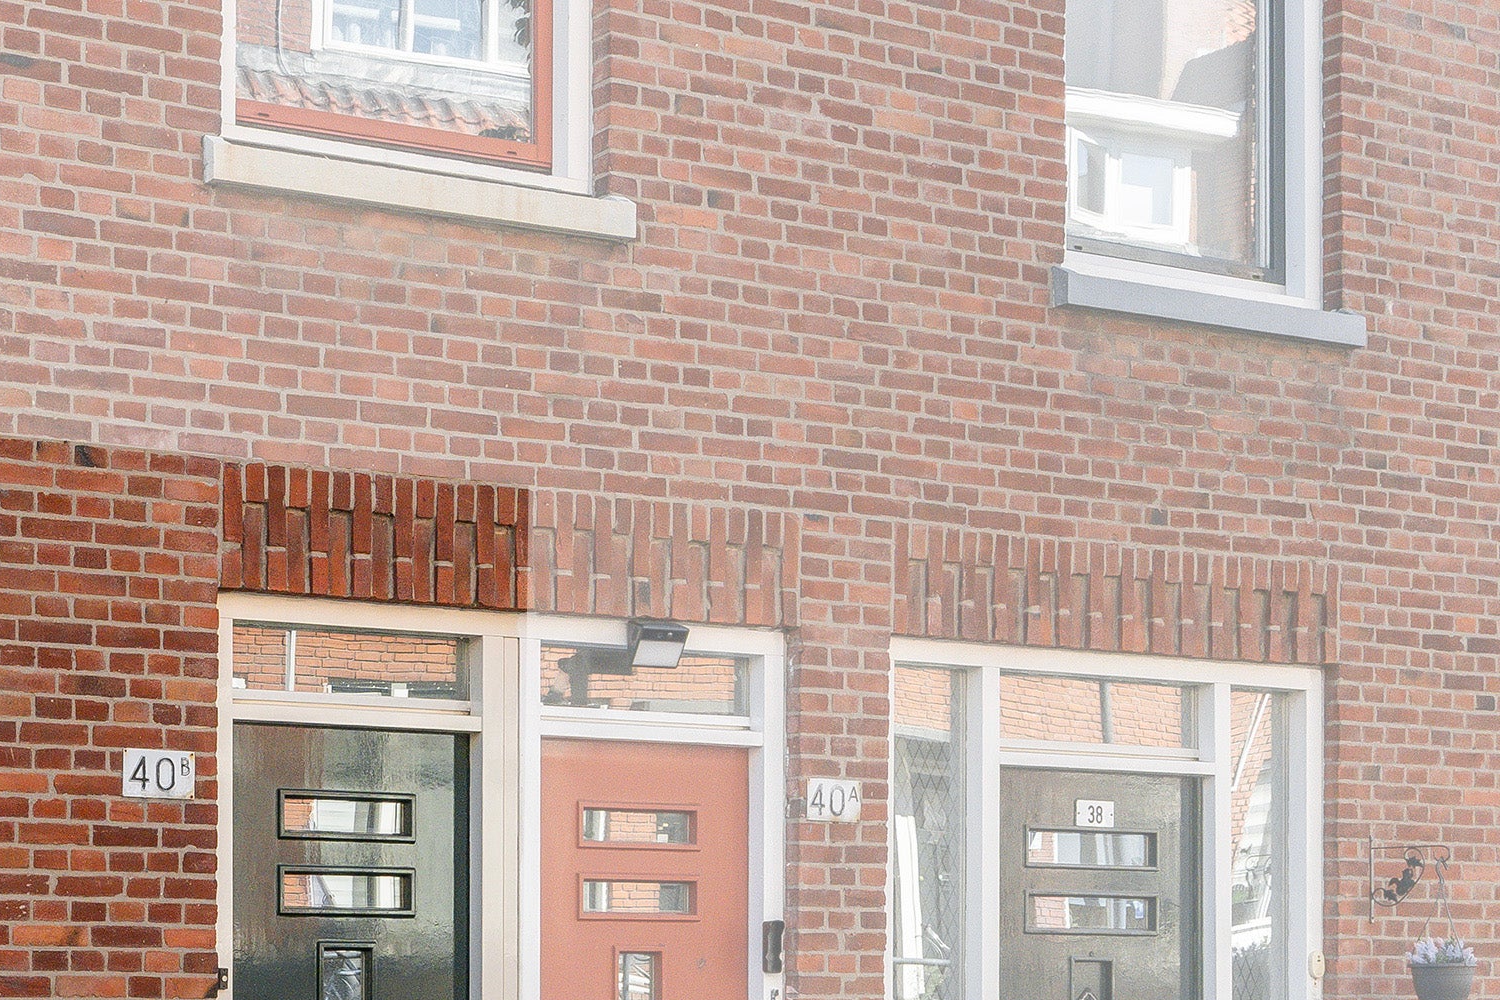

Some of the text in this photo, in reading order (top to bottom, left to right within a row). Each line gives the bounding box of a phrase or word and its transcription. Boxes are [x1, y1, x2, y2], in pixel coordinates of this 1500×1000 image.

[128, 755, 190, 792] 40B
[810, 783, 859, 816] 40A
[1087, 805, 1103, 824] 38
